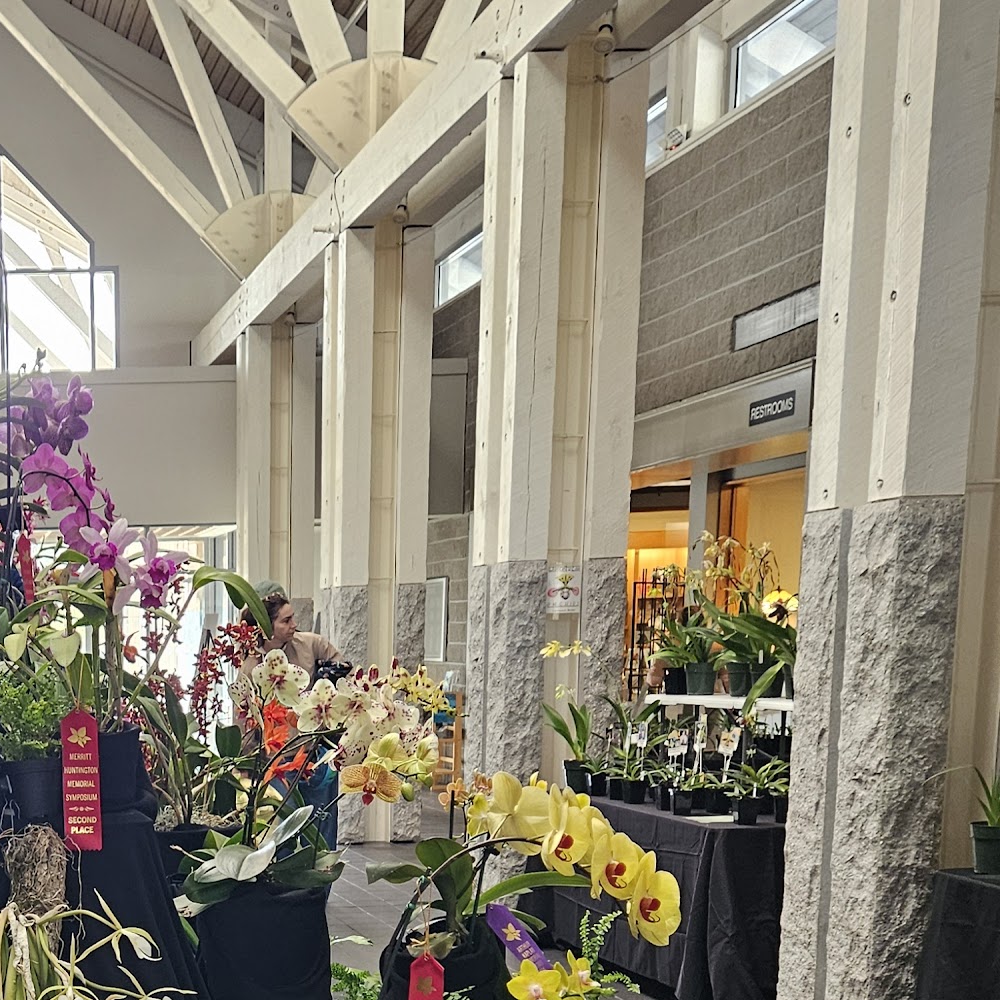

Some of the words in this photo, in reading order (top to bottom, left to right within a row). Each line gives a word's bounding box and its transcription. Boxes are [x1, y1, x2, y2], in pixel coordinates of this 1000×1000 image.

[751, 397, 793, 420] RESTROOMS
[69, 753, 92, 761] MERRITT
[67, 780, 95, 788] MEMORIAL
[65, 793, 98, 801] SYMPOSIUM
[68, 816, 97, 824] SECOND
[71, 826, 94, 834] PLACE
